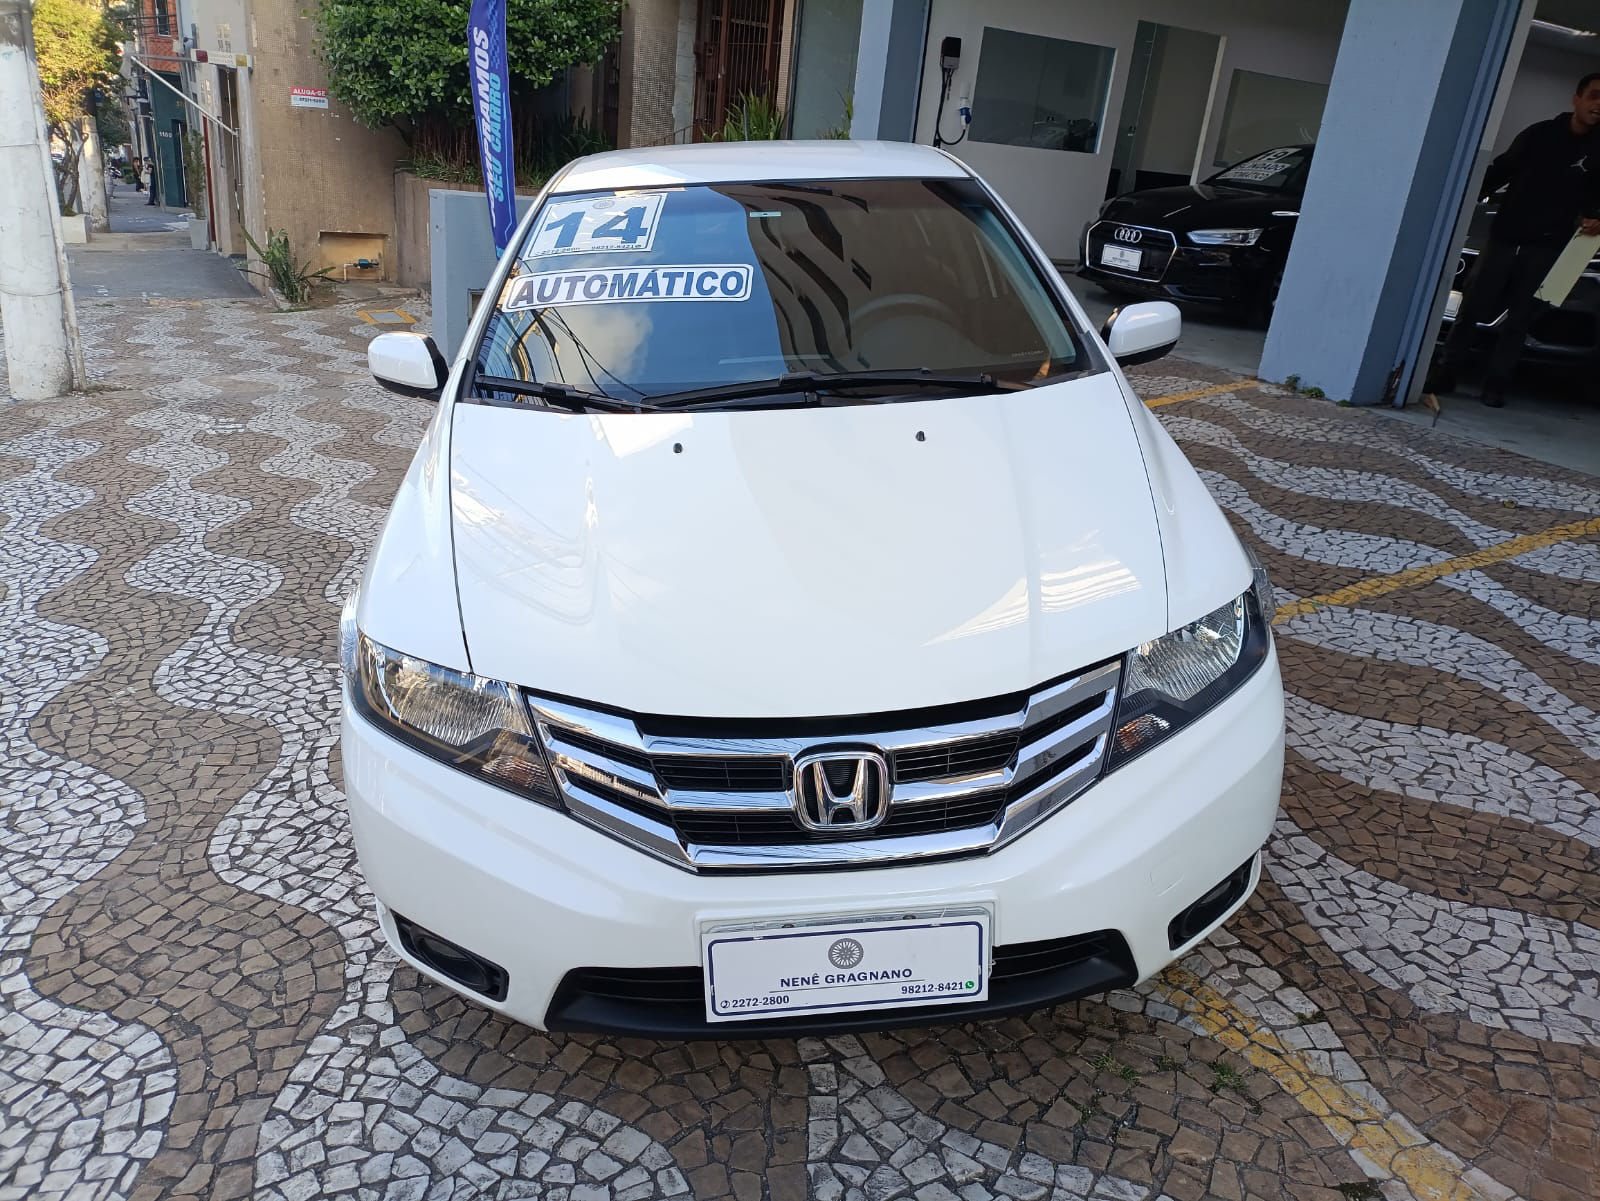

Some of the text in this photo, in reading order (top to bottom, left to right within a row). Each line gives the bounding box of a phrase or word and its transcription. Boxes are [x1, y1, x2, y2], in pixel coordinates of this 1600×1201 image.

[489, 72, 505, 202] SEU CARRO
[544, 206, 649, 249] 14
[510, 269, 745, 307] AUTOMÁTICO
[780, 968, 913, 988] NENÊ GRAGNANO
[901, 981, 964, 995] 98212-8421
[732, 995, 790, 1009] 2272-2800
